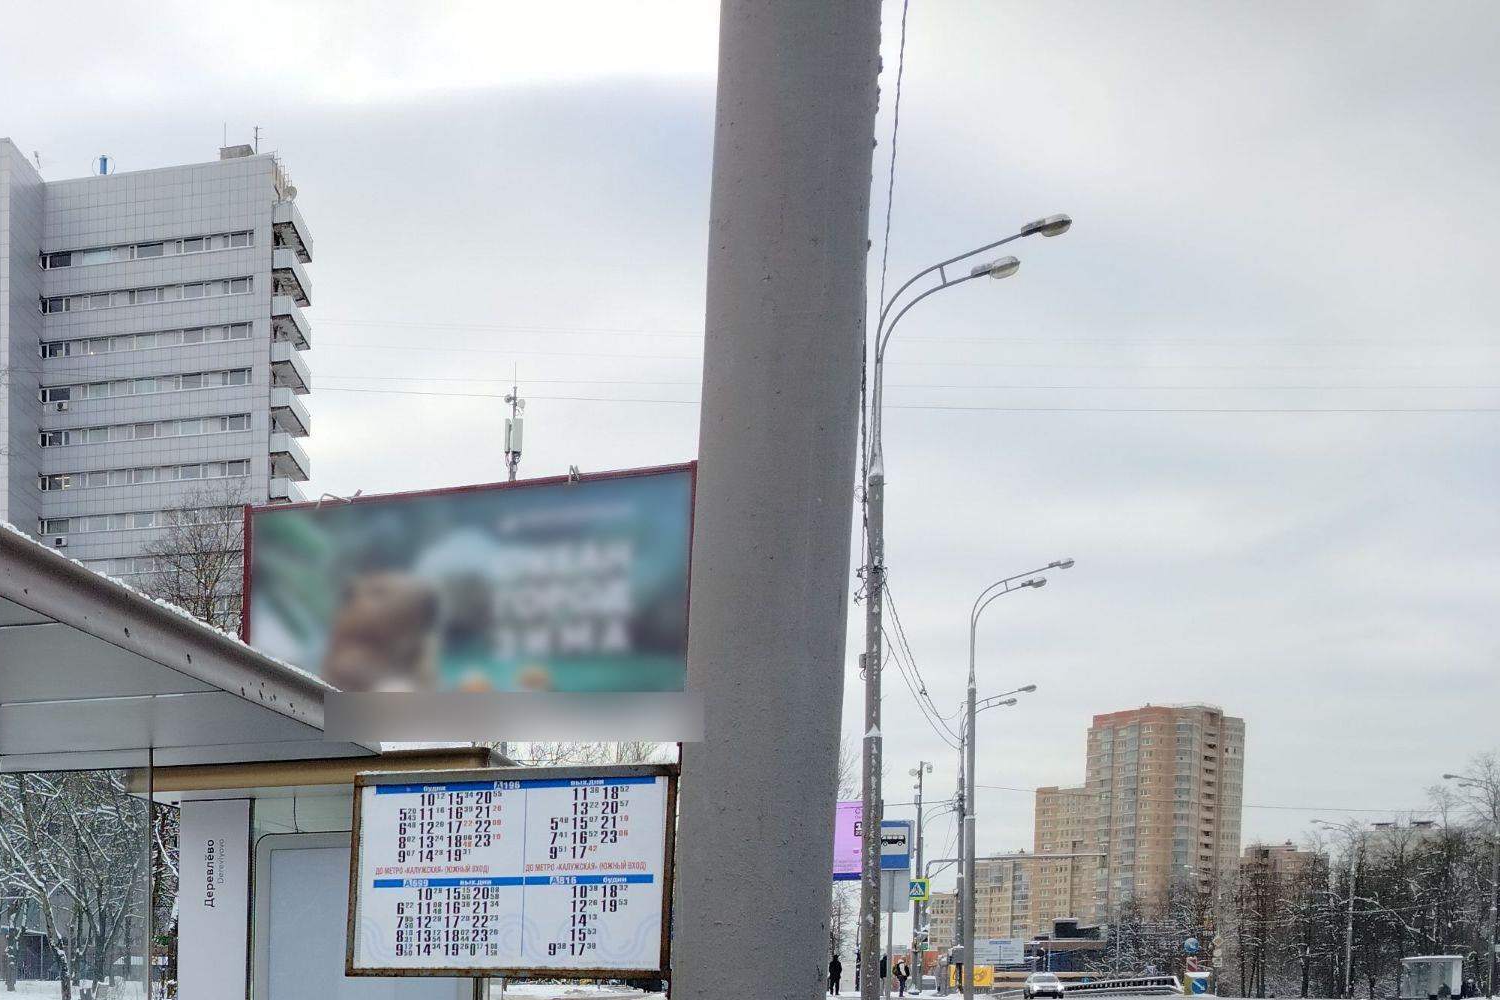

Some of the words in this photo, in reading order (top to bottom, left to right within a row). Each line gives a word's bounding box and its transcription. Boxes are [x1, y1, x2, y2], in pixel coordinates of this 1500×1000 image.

[420, 794, 435, 806] 10
[448, 793, 463, 805] 15
[476, 792, 491, 804] 20
[573, 788, 587, 800] 11
[603, 786, 618, 799] 18
[400, 809, 406, 820] 5
[420, 808, 432, 820] 11
[448, 807, 462, 819] 16
[476, 806, 489, 818] 21
[572, 802, 588, 815] 13
[602, 801, 618, 814] 20
[399, 823, 406, 835] 6
[420, 822, 434, 834] 12
[448, 821, 462, 833] 17
[475, 820, 491, 832] 22
[551, 817, 558, 830] 5
[572, 817, 587, 830] 15
[601, 816, 616, 829] 21
[399, 837, 406, 849] 8
[420, 836, 434, 848] 13
[447, 835, 462, 848] 18
[475, 834, 491, 847] 23
[551, 832, 557, 845] 7
[571, 831, 587, 844] 16
[601, 830, 617, 843] 23
[398, 850, 405, 862] 9
[420, 850, 434, 862] 14
[447, 849, 461, 861] 19
[550, 847, 557, 859] 9
[571, 846, 586, 859] 17
[205, 839, 215, 907] Деревлёво
[417, 888, 432, 900] 10
[446, 888, 460, 900] 15
[473, 887, 489, 900] 20
[572, 885, 587, 898] 10
[602, 885, 617, 898] 18
[397, 902, 404, 914] 6
[417, 902, 430, 914] 11
[445, 902, 460, 914] 16
[473, 901, 487, 914] 21
[571, 900, 587, 912] 12
[601, 900, 617, 912] 19
[397, 916, 404, 928] 7
[417, 916, 431, 928] 12
[445, 916, 459, 928] 17
[472, 916, 488, 928] 22
[570, 914, 586, 927] 14
[396, 930, 404, 942] 8
[416, 930, 430, 942] 13
[444, 930, 459, 942] 18
[472, 930, 488, 942] 23
[570, 929, 586, 941] 15
[396, 944, 403, 956] 9
[416, 944, 430, 956] 14
[444, 944, 459, 956] 19
[470, 944, 476, 956] 0
[485, 944, 489, 956] 1
[549, 943, 556, 955] 9
[570, 943, 585, 955] 17
